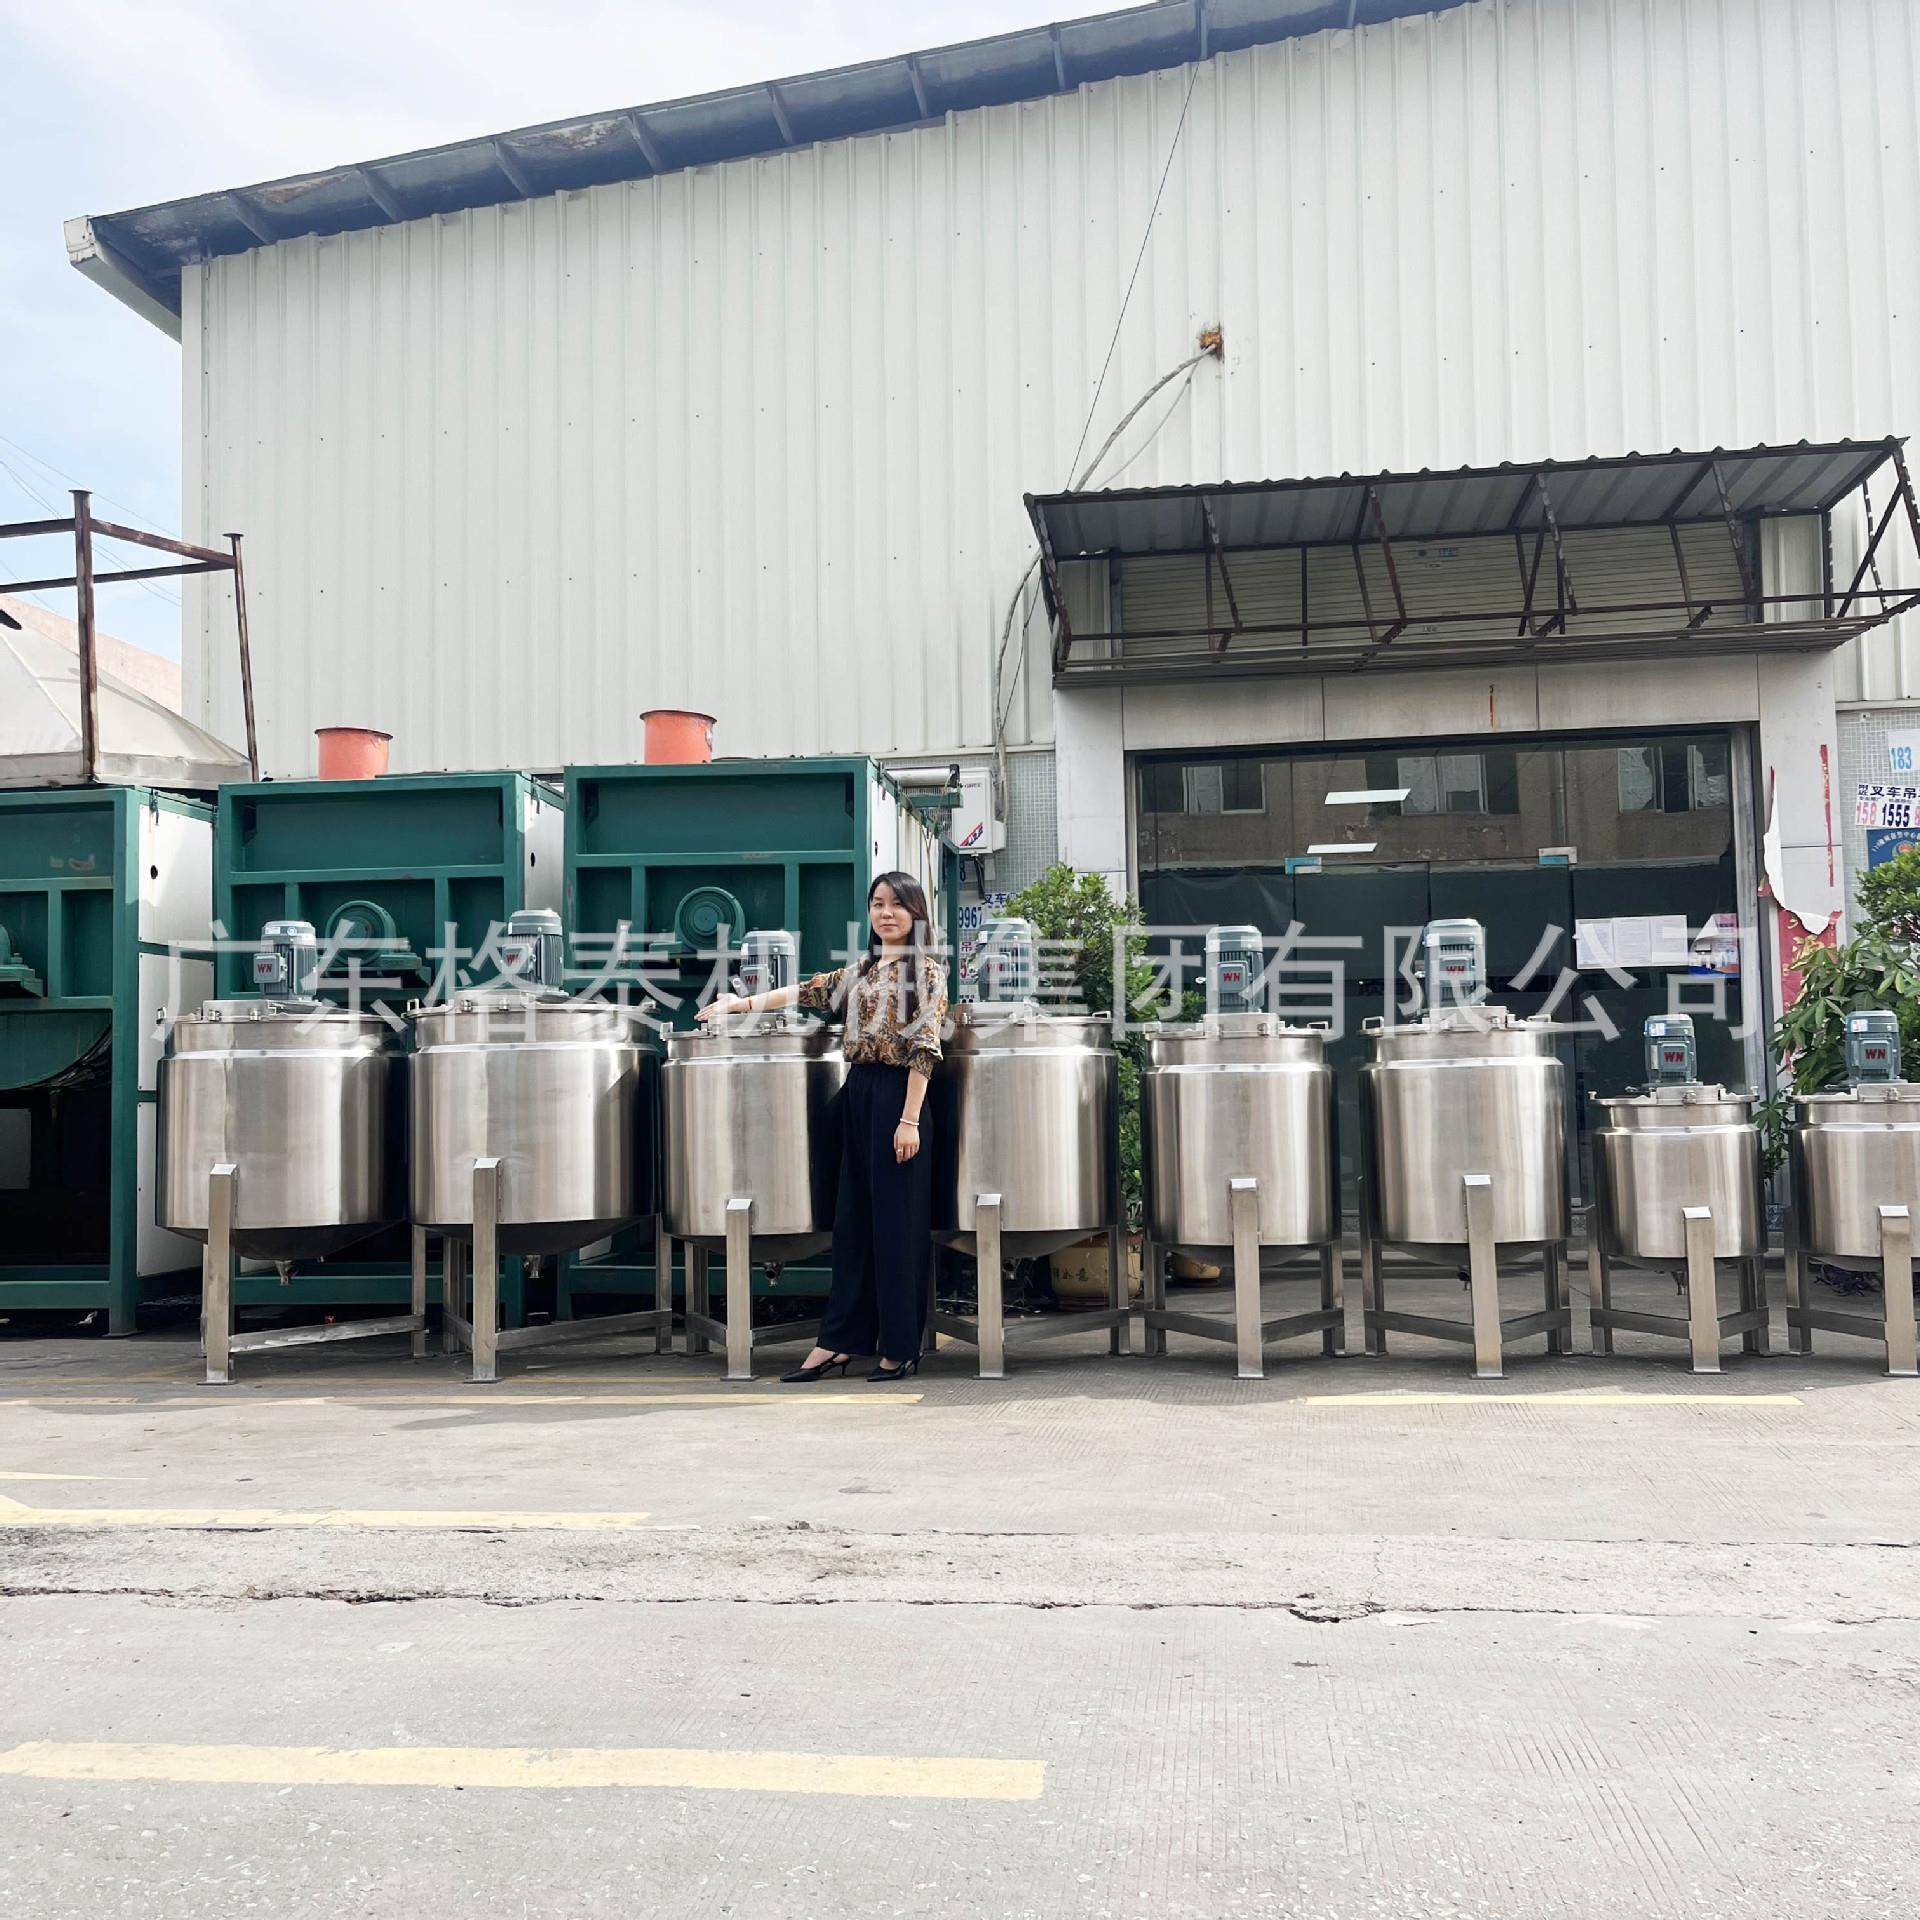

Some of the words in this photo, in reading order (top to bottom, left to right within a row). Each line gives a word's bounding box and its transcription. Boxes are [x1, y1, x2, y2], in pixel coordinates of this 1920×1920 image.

[1890, 746, 1912, 770] 183
[1856, 800, 1878, 825] 158
[1882, 802, 1911, 827] 1555
[257, 963, 273, 973] WN
[1446, 965, 1465, 976] WN
[1223, 972, 1241, 983] WN
[1664, 1051, 1684, 1063] WN
[1865, 1048, 1886, 1060] WN
